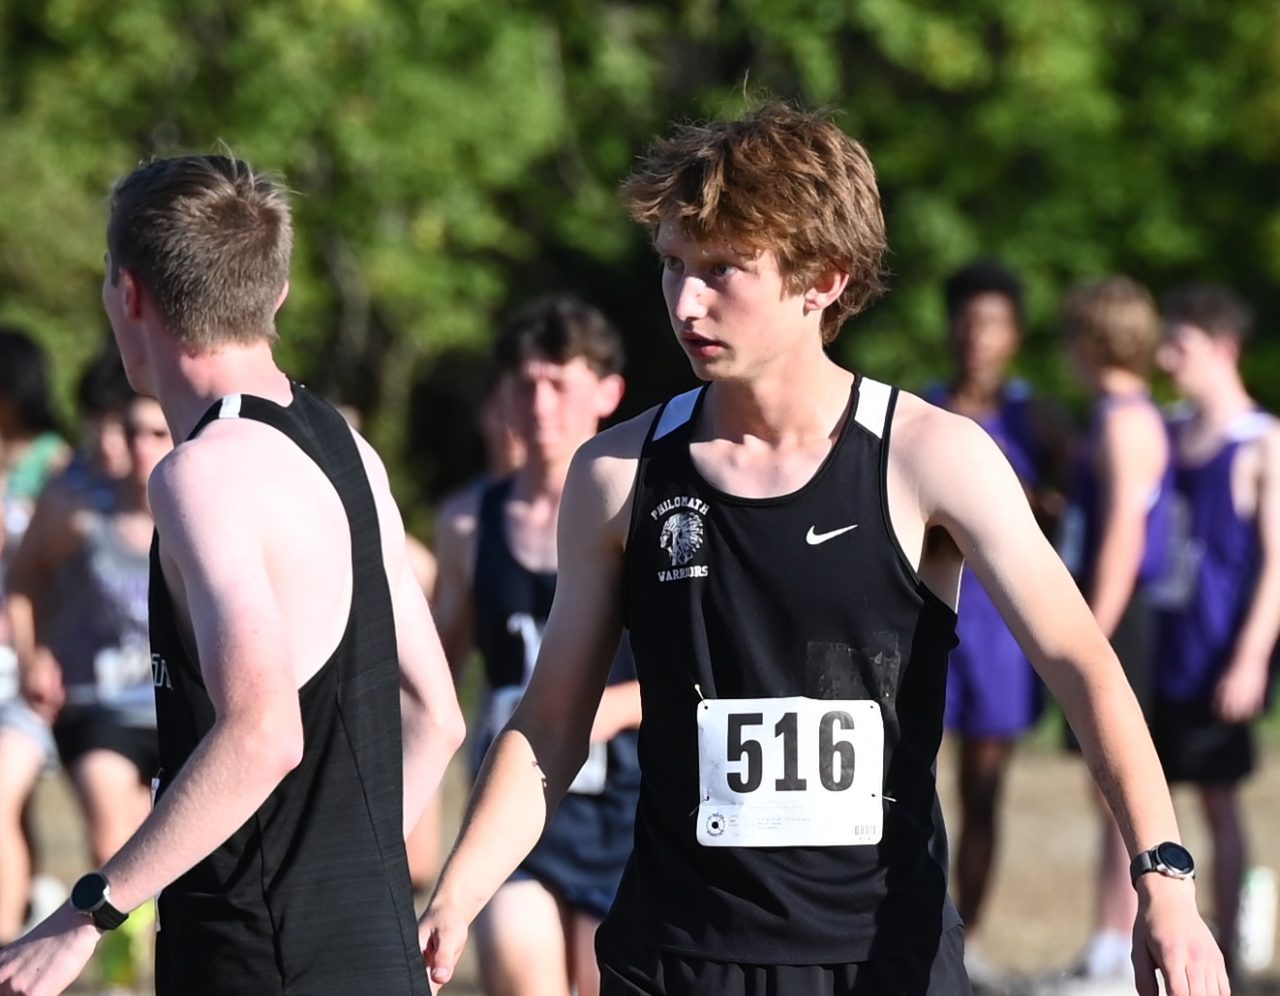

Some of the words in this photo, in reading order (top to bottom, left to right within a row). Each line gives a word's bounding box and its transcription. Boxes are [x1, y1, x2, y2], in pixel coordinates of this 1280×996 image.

[650, 496, 711, 520] PHILOMATH
[657, 565, 709, 582] WARRIORS
[726, 710, 856, 794] 516
